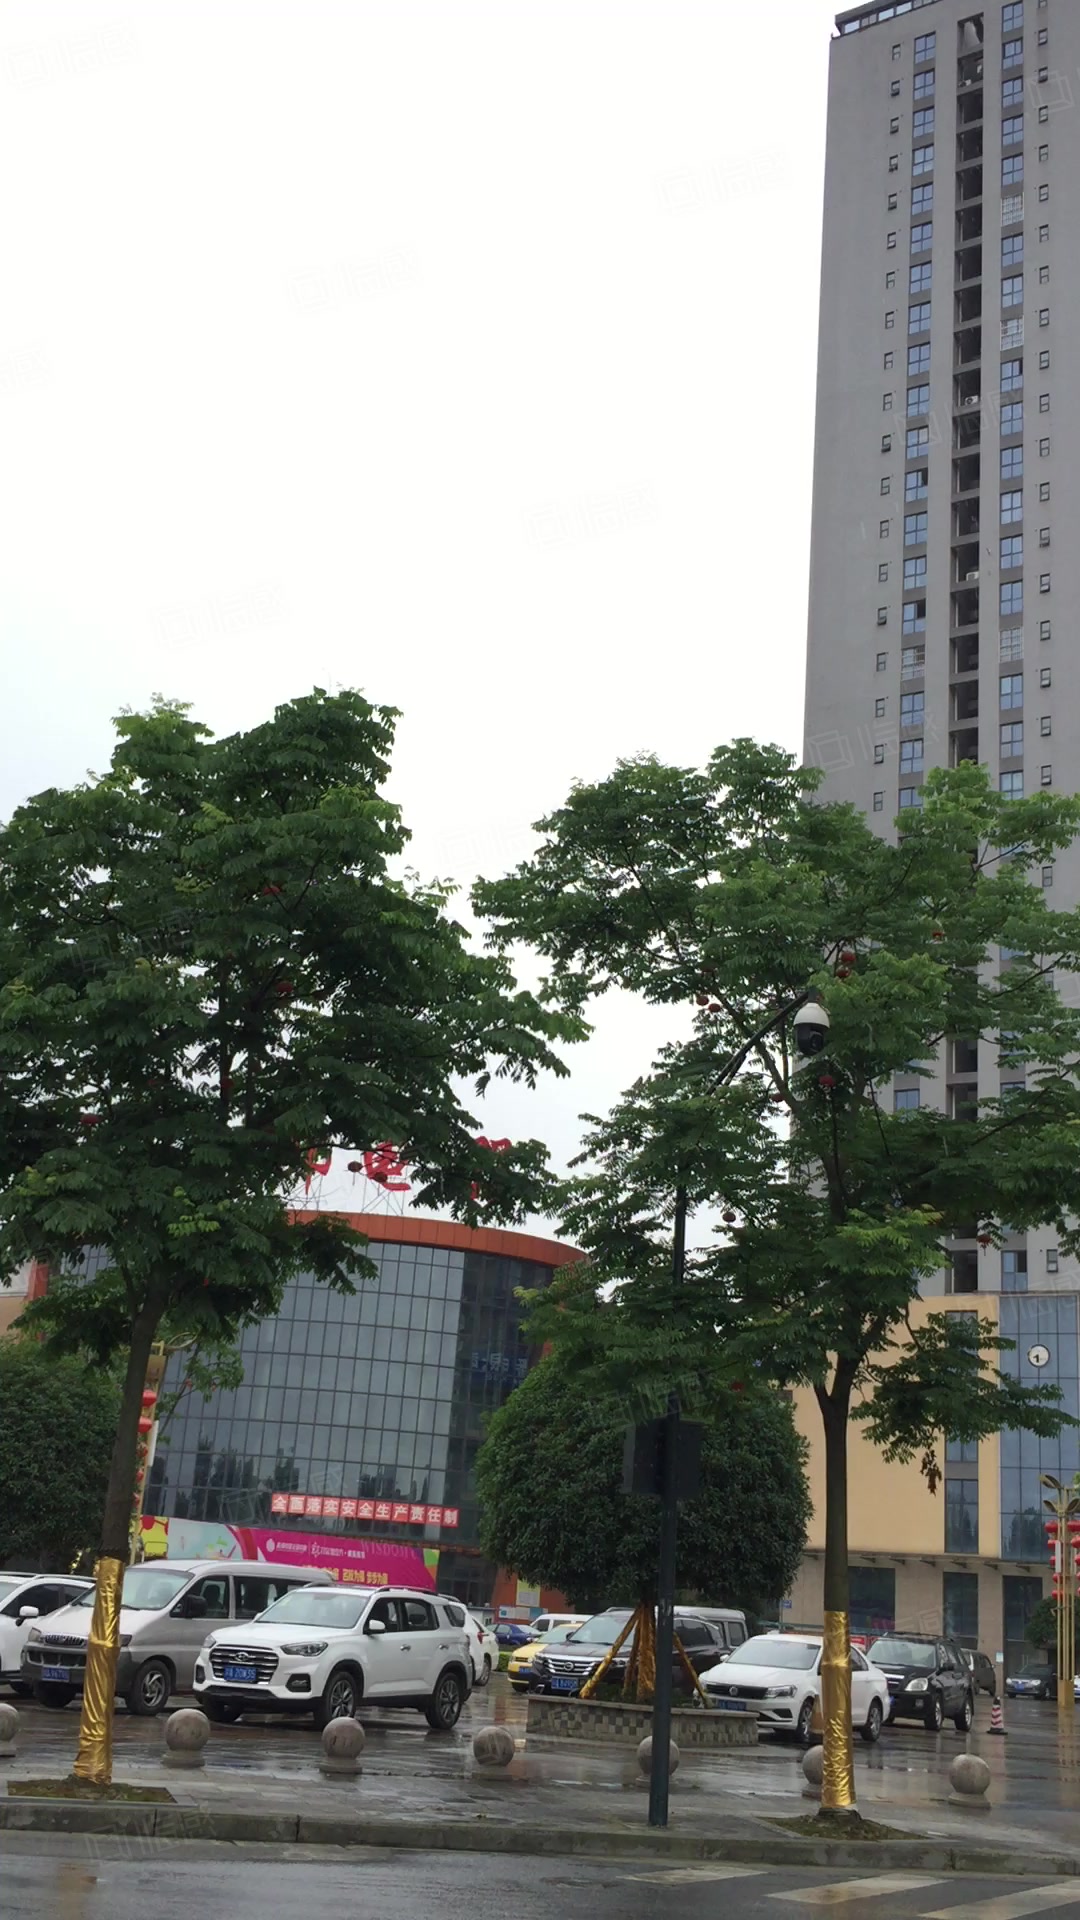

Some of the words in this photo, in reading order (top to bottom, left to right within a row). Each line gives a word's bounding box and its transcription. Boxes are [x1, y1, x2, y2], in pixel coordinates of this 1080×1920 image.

[272, 1494, 458, 1526] 全面落实安全生产责任制
